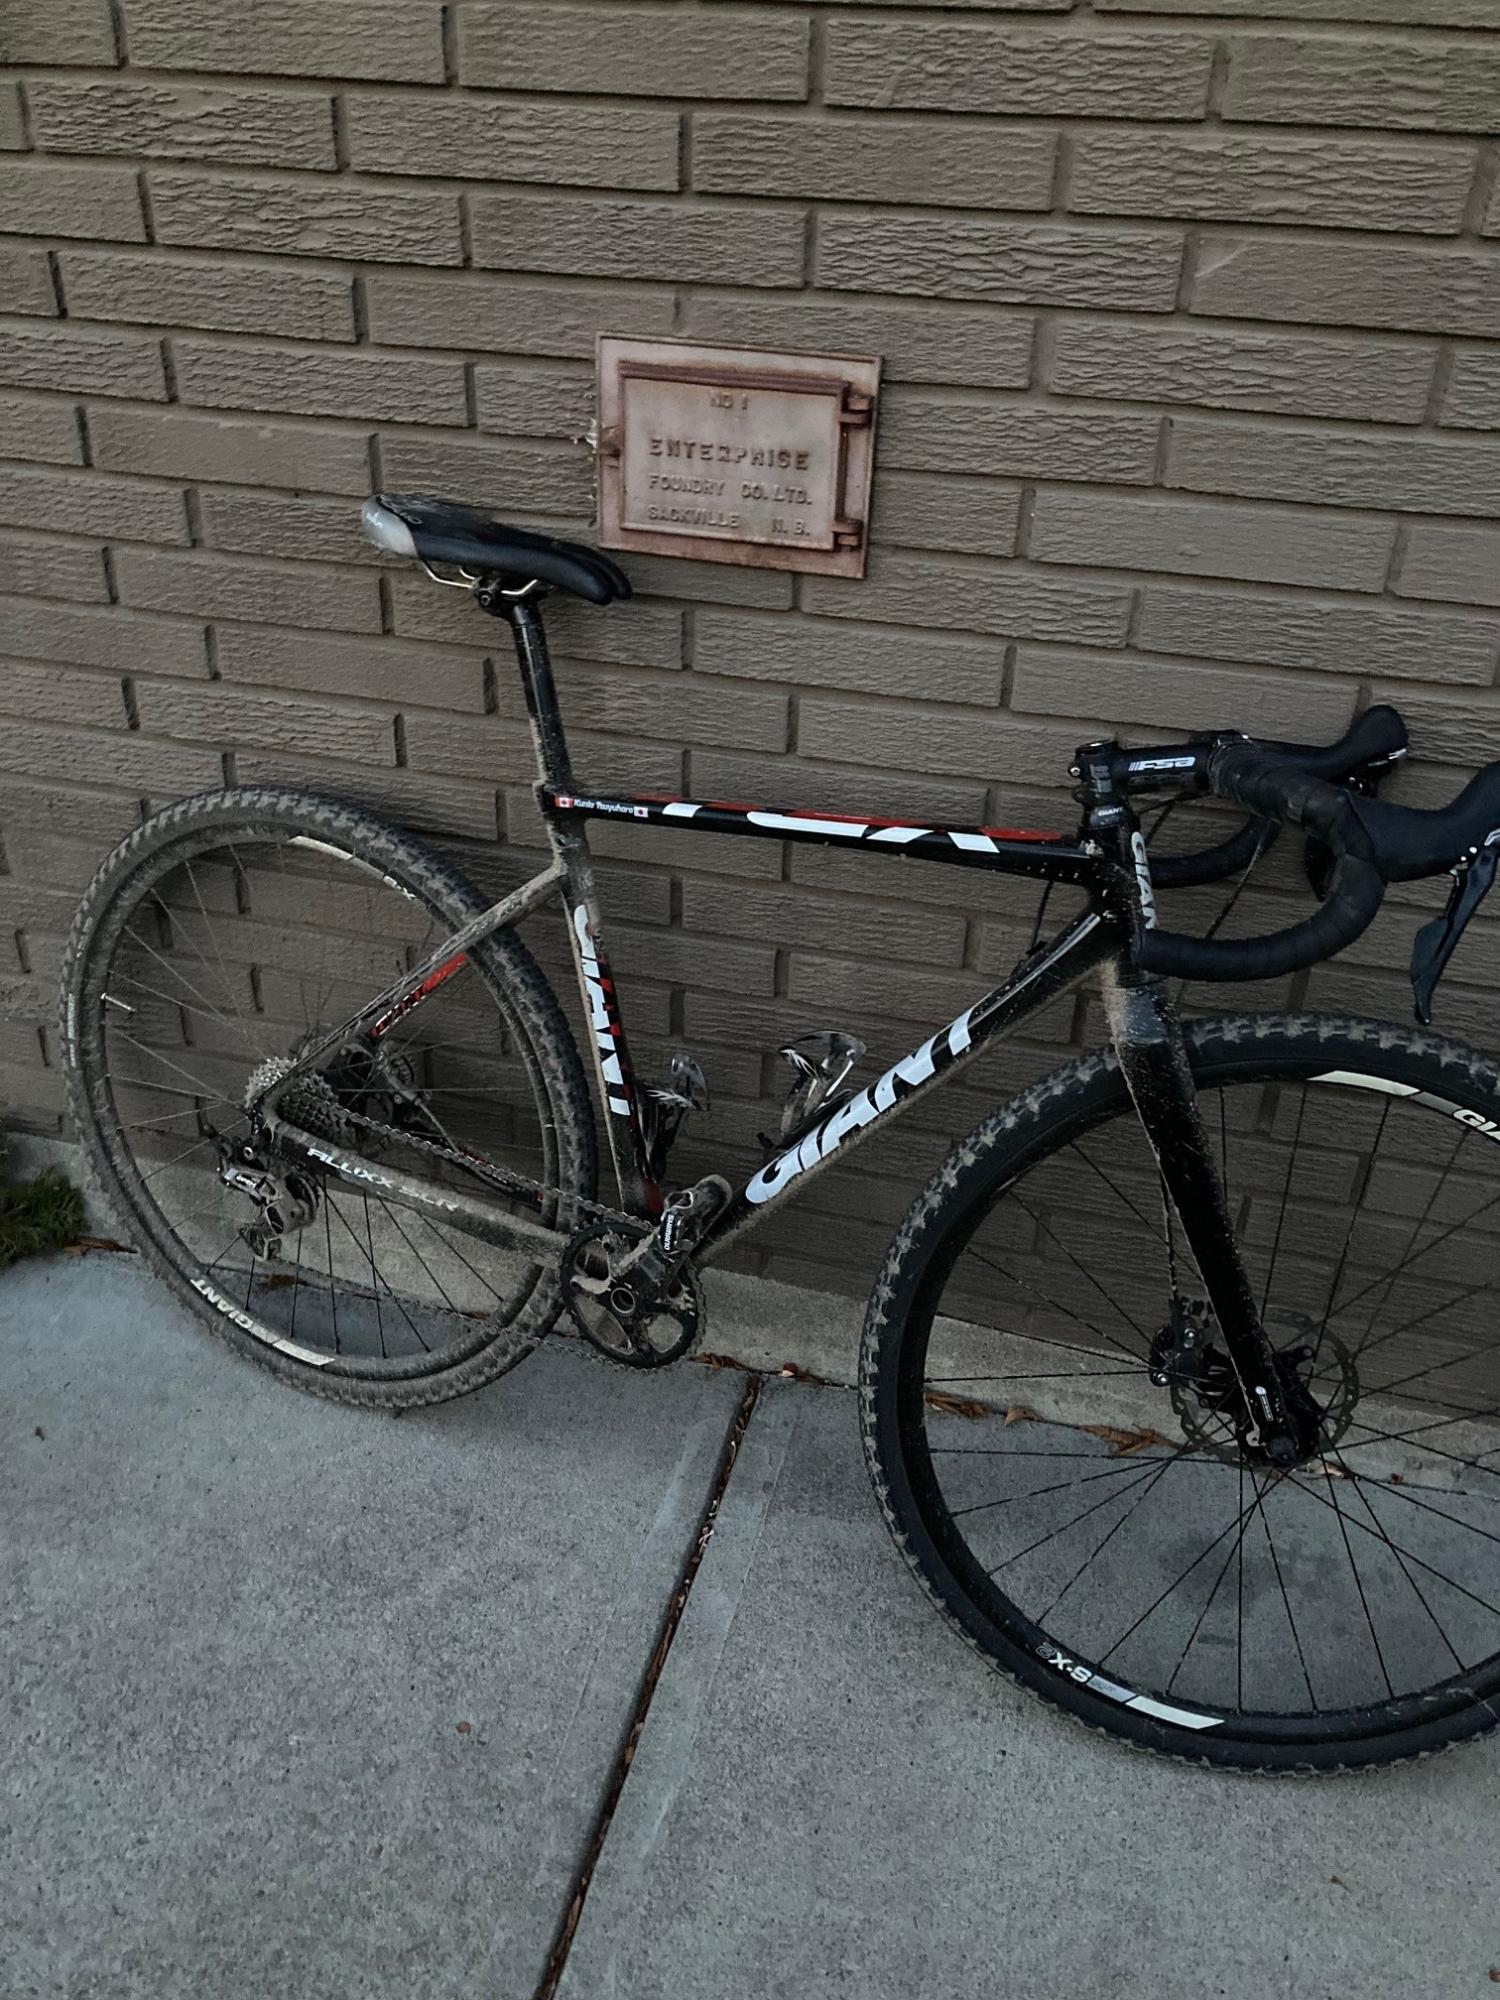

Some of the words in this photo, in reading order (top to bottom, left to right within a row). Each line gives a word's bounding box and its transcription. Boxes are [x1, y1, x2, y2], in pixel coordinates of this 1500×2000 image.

[650, 439, 810, 470] ENTERPRISE
[649, 474, 726, 497] FOUNDRY
[1131, 832, 1158, 929] GIAN
[664, 1214, 675, 1251] SHIMANO
[190, 1279, 254, 1329] GIANT
